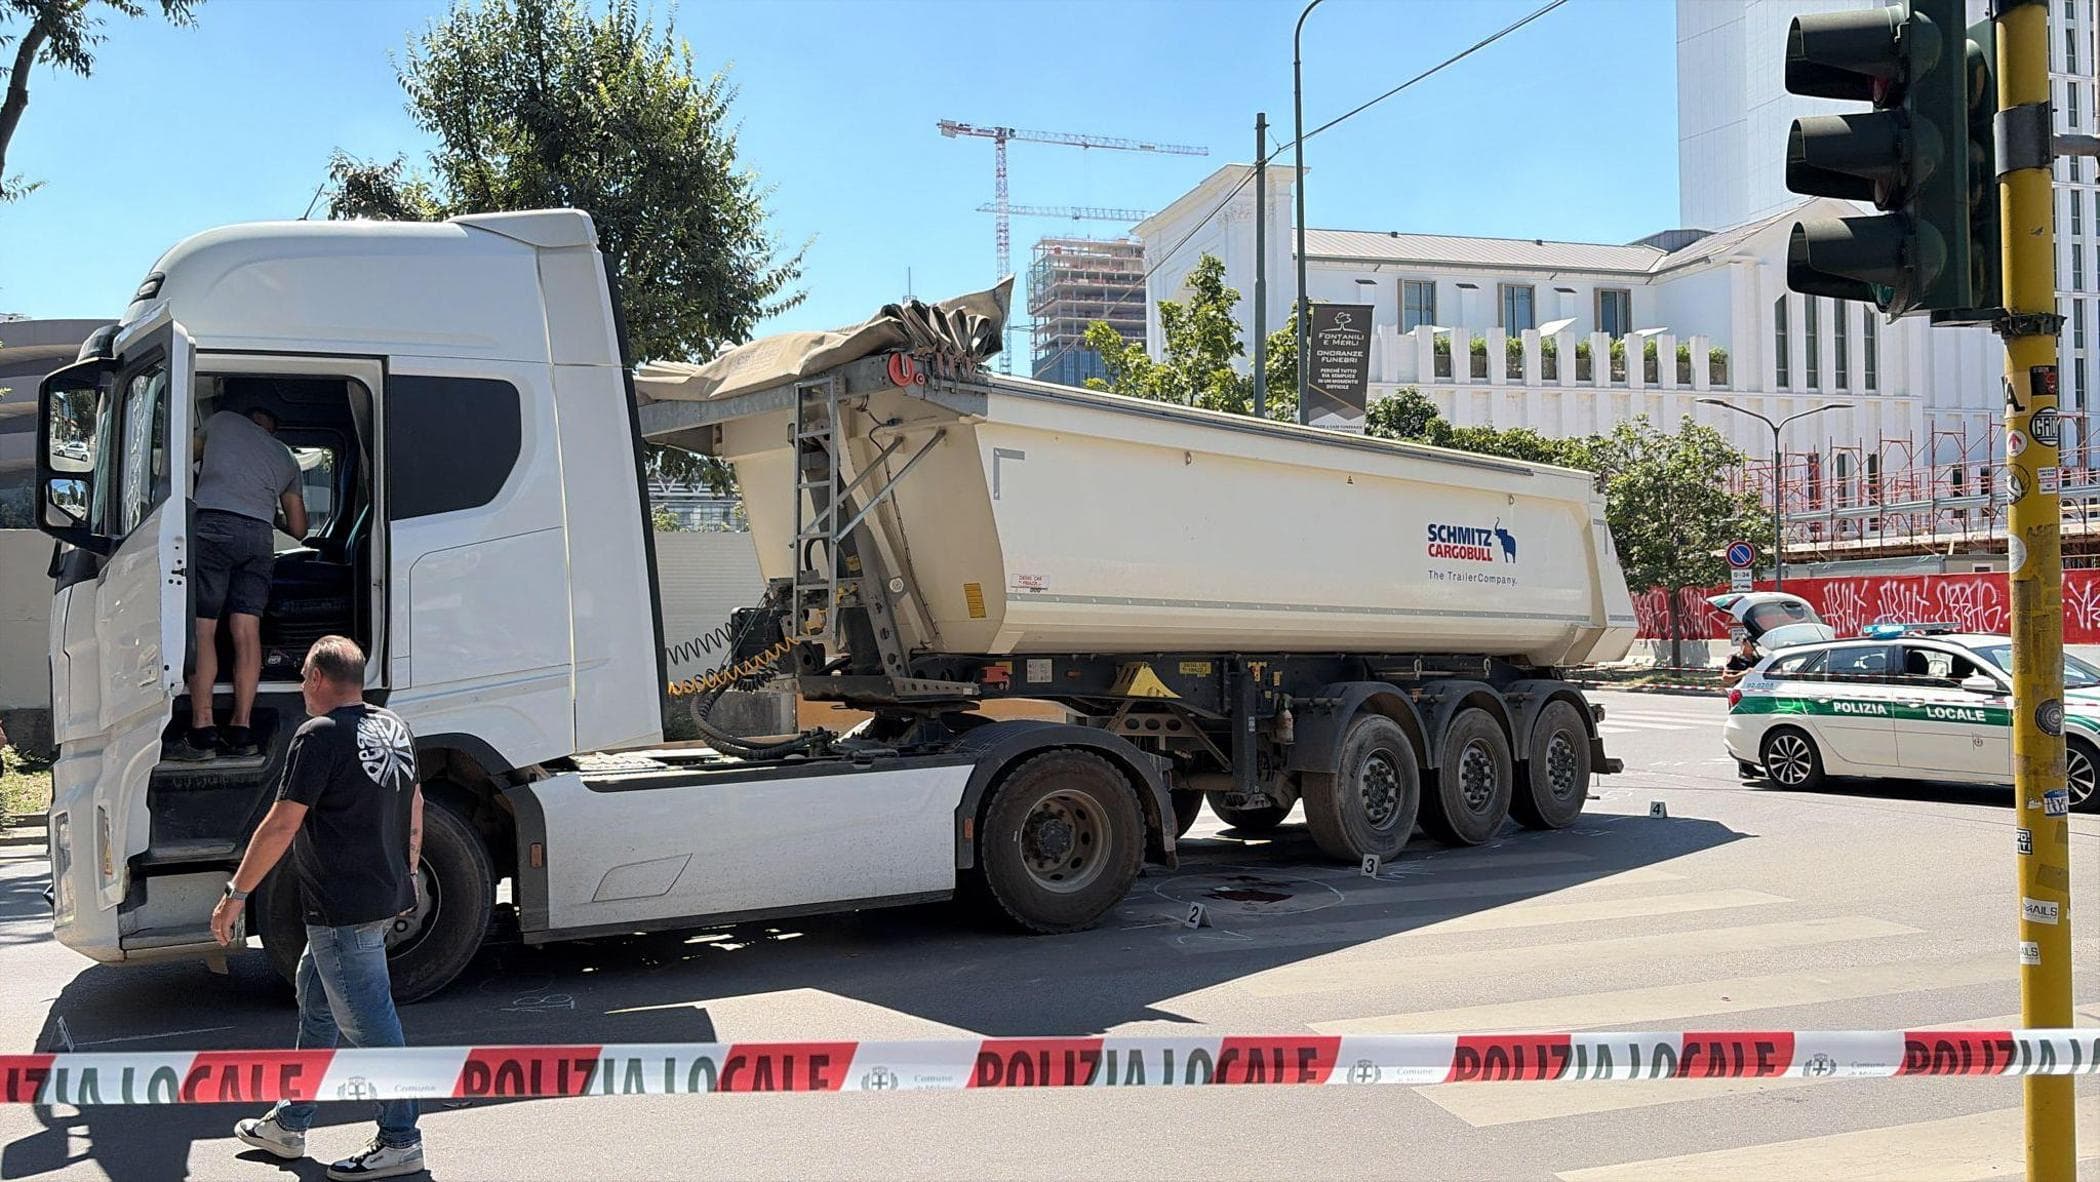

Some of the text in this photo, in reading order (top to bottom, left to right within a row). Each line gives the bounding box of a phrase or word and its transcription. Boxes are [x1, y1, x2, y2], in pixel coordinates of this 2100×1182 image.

[1318, 332, 1364, 340] FONTANILI
[1427, 523, 1492, 547] SCHMITZ
[1427, 543, 1493, 562] CARGOBULL
[1428, 570, 1445, 580] The
[1832, 701, 1986, 722] POLIZIA LOCALE
[1652, 803, 1662, 816] 4
[1364, 858, 1375, 874] 3
[1188, 906, 1199, 924] 2
